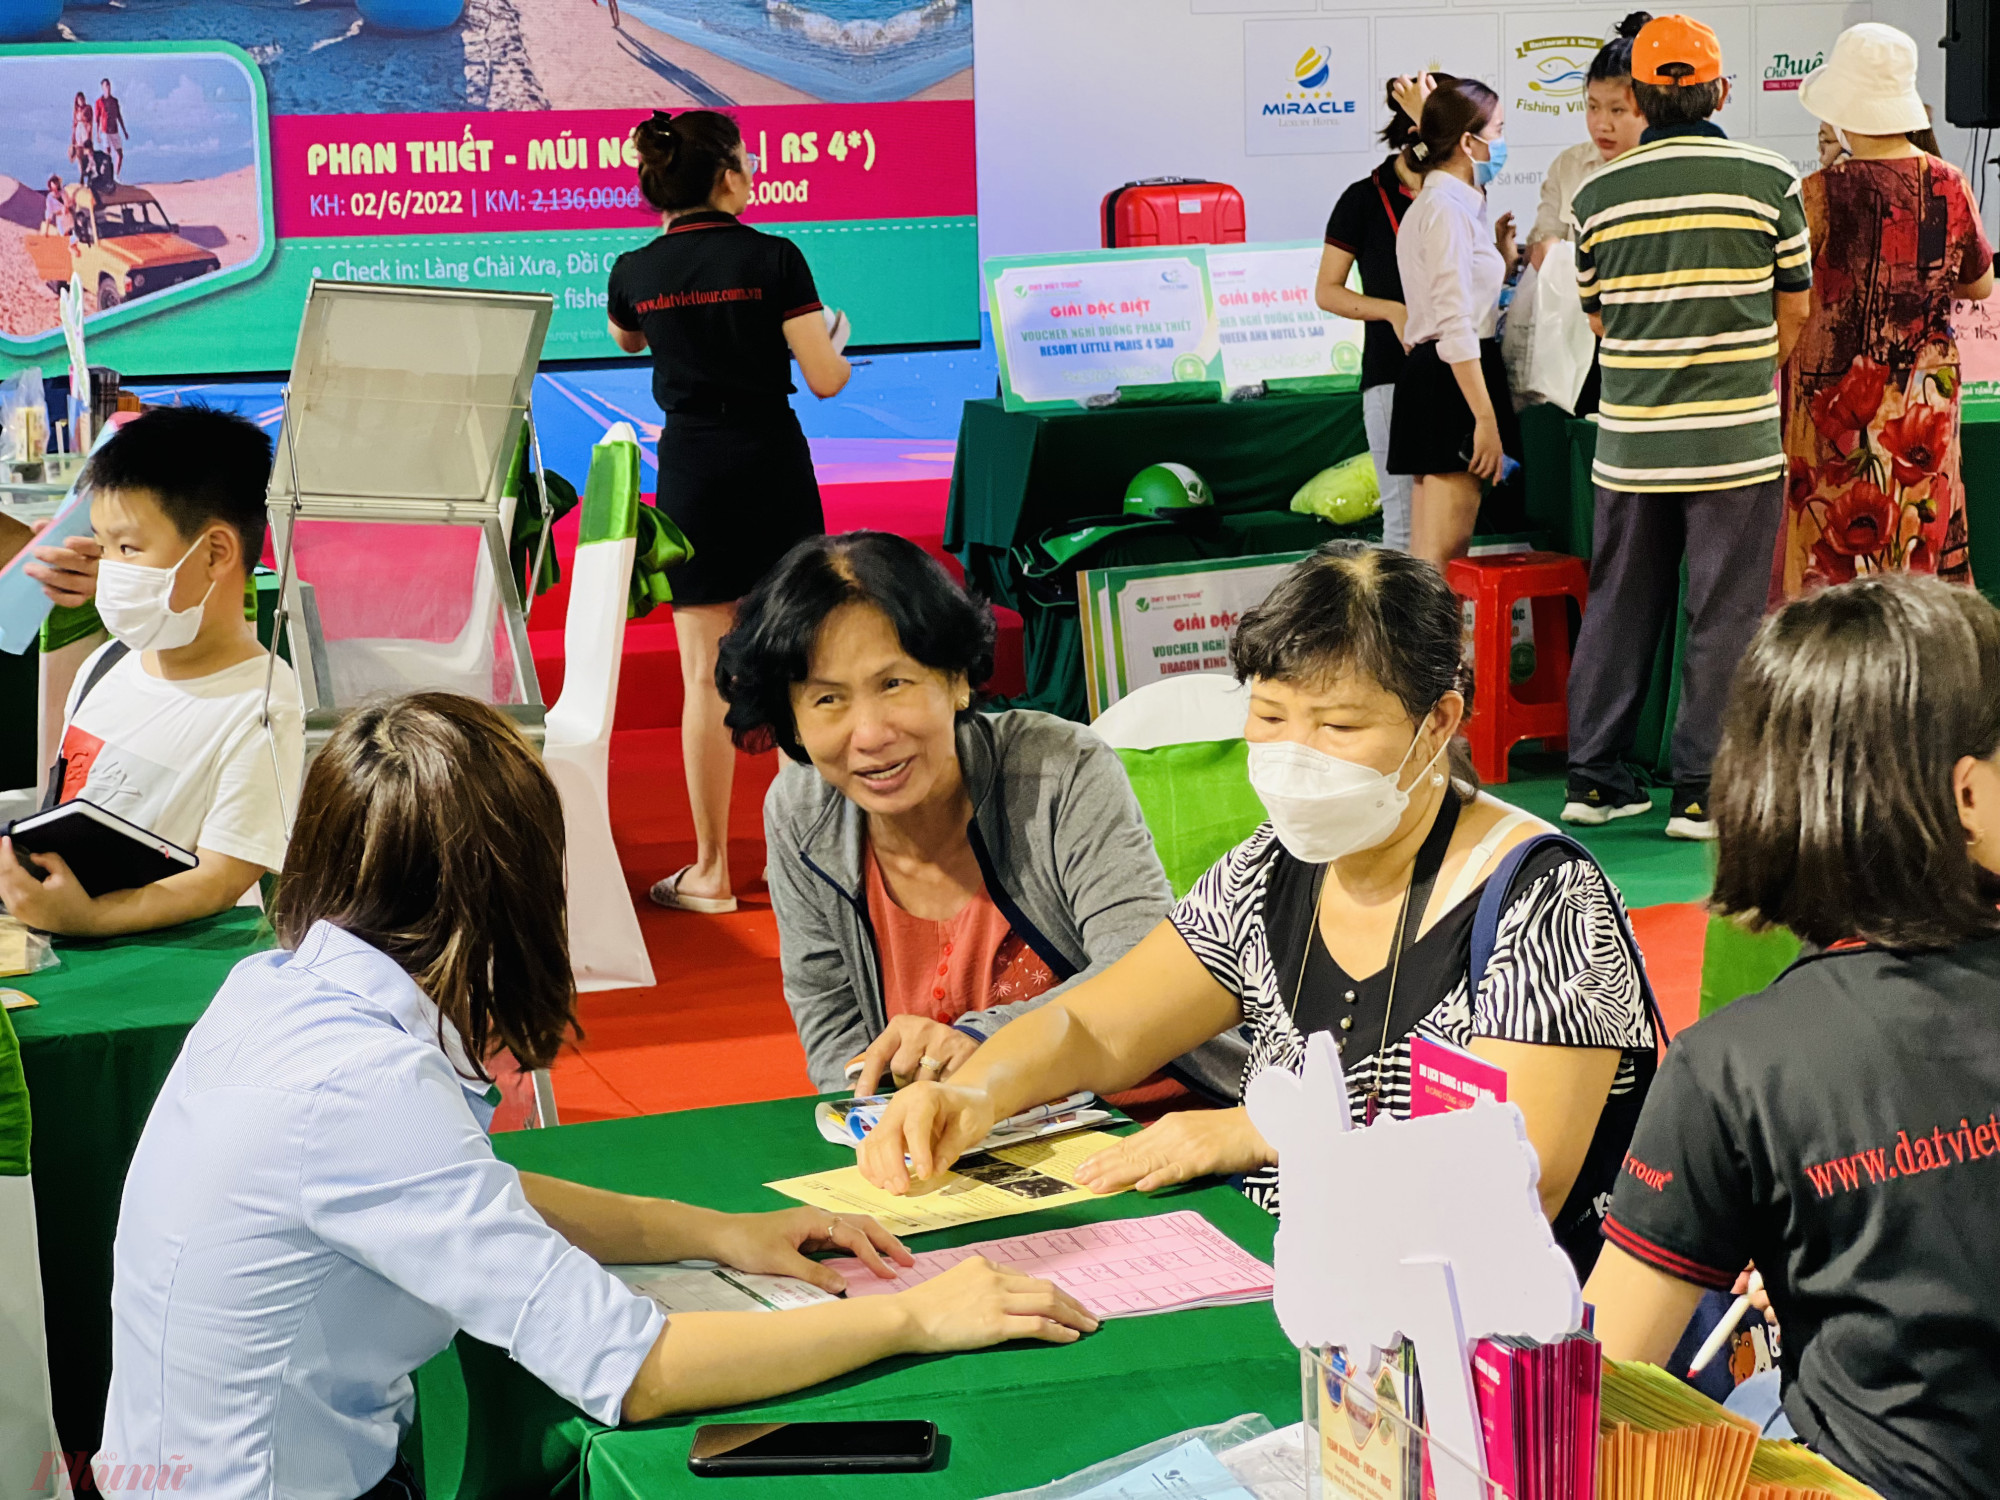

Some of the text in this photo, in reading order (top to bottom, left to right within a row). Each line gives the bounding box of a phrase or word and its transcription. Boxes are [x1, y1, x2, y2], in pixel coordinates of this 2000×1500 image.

[1577, 38, 1597, 47] Hotel
[1262, 101, 1355, 115] MIRACLE
[1516, 98, 1584, 116] Fishing Vil
[307, 142, 397, 176] PHAN
[406, 124, 493, 173] THIẾT
[527, 129, 588, 171] MŨI
[781, 131, 819, 163] RS
[310, 194, 346, 217] KH:
[350, 189, 463, 220] 02/6/2022
[485, 189, 525, 213] KM:
[333, 259, 391, 281] Check
[395, 258, 419, 279] in:
[424, 257, 469, 282] Làng
[473, 254, 514, 278] Chài
[519, 255, 561, 278] Xưa,
[566, 250, 598, 274] Đồi
[1218, 285, 1309, 307] GIẢI ĐẶC BIỆT
[1050, 297, 1151, 319] GIẢI ĐẶC BIỆT
[1021, 328, 1069, 342] VOUCHER
[1136, 321, 1163, 335] PHAN
[1165, 318, 1192, 332] THIẾT
[1270, 328, 1297, 341] HOTEL
[1308, 326, 1325, 338] SAO
[1040, 344, 1077, 357] RESORT
[1080, 341, 1112, 354] LITTLE
[1114, 339, 1144, 352] PARIS
[1155, 337, 1175, 349] SAO
[1173, 610, 1240, 632] GIẢI ĐẶC
[1152, 641, 1199, 658] VOUCHER
[1160, 656, 1227, 674] DRAGON KING
